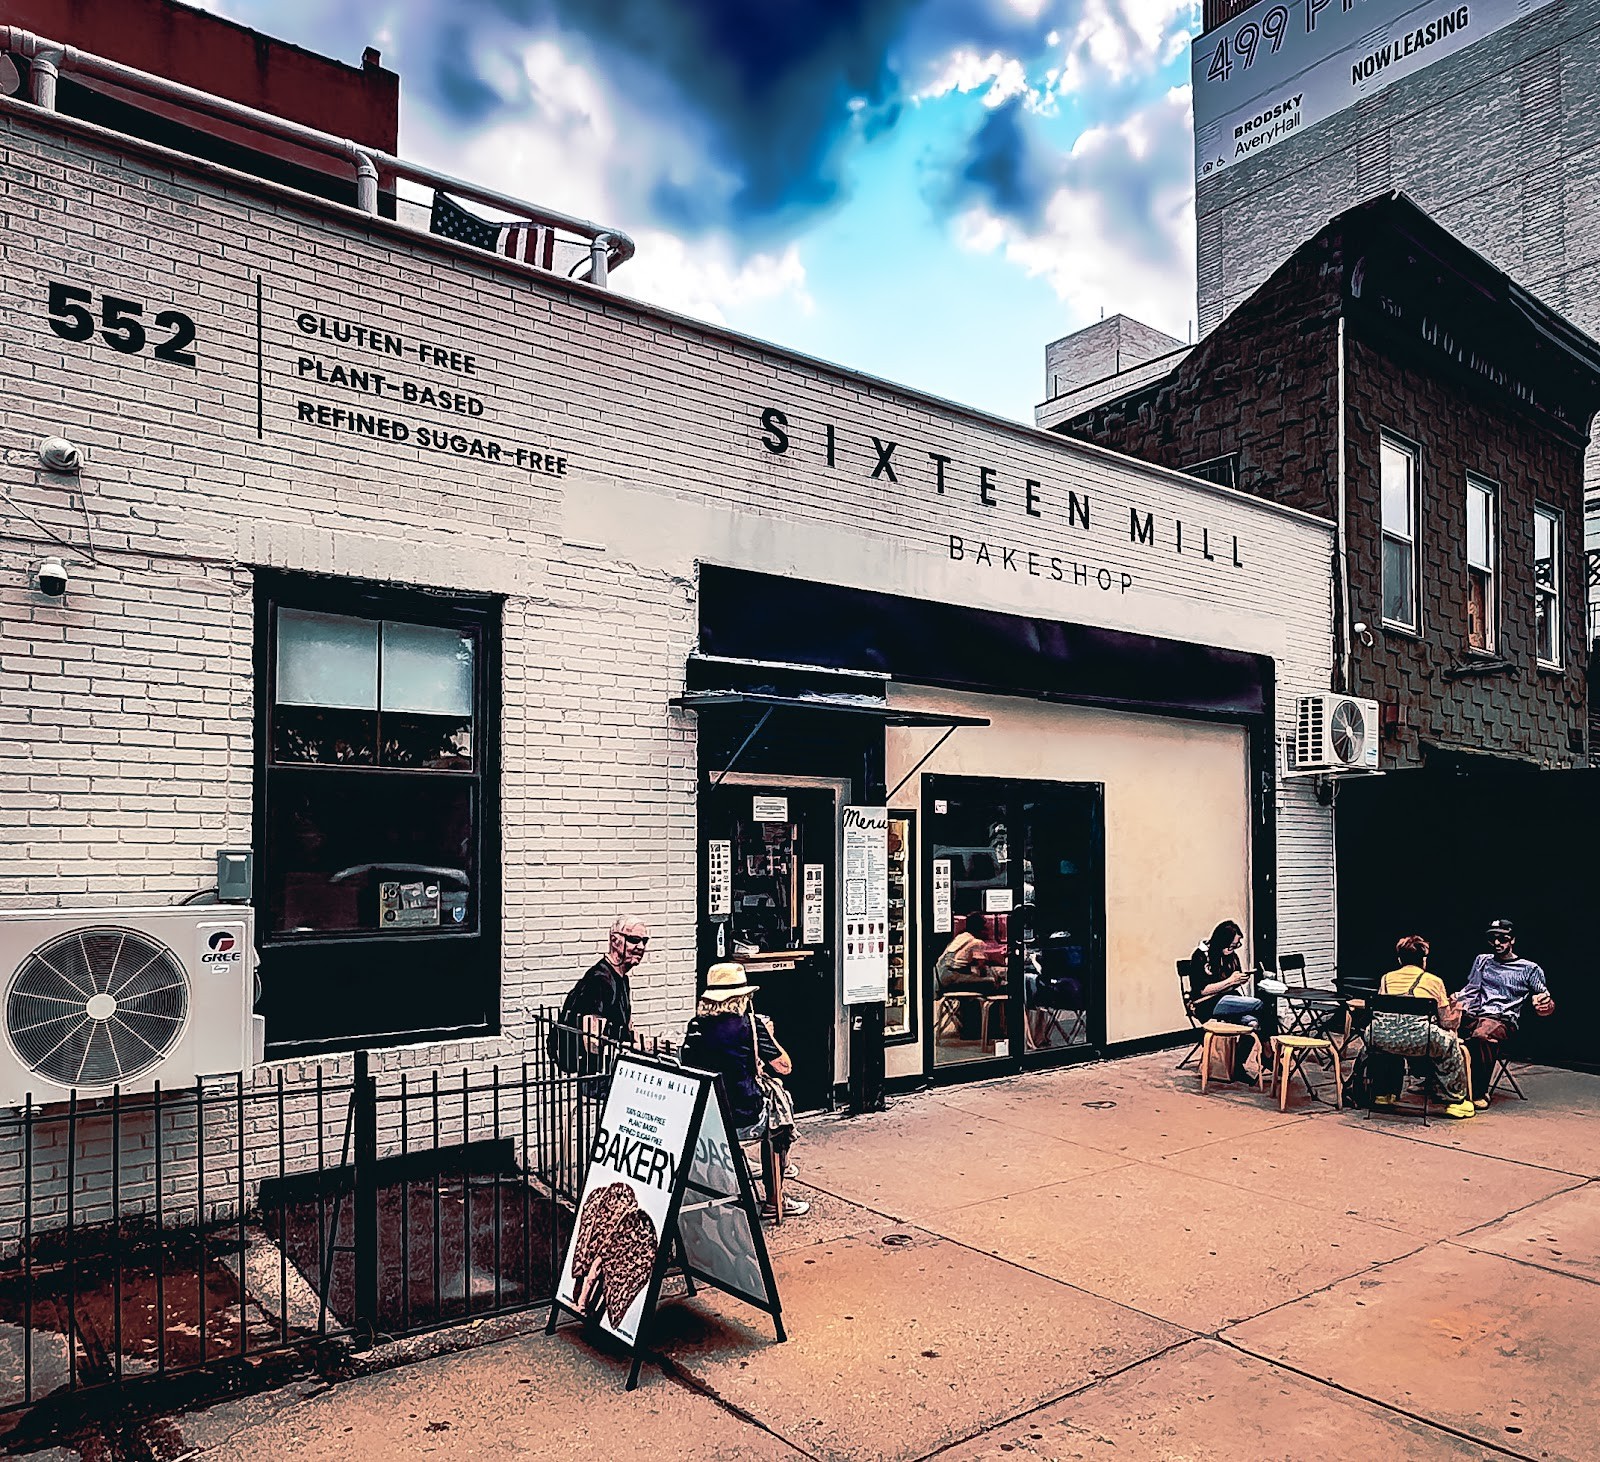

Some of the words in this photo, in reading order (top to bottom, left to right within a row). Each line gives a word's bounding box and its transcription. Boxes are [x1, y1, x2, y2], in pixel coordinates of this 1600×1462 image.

[1207, 5, 1289, 82] 499
[1352, 45, 1391, 85] NOW
[1394, 6, 1468, 61] LEASING
[1235, 93, 1302, 139] BRODSKY
[1235, 112, 1300, 158] AveryHall
[49, 281, 196, 365] 552
[297, 314, 476, 374] GLUTEN-FREE
[299, 357, 483, 417] PLANT-BASED
[299, 402, 410, 443] REFINED
[416, 427, 567, 475] SUGAR-FREE
[761, 408, 1090, 529] SIXTEEN
[1130, 508, 1243, 568] MILL
[950, 535, 1133, 594] BAKESHOP
[843, 809, 889, 830] Menu
[201, 952, 241, 963] GREE
[619, 1067, 662, 1086] SIXTEEN
[668, 1080, 694, 1096] MILL
[636, 1087, 666, 1101] BAKESHOP
[591, 1128, 680, 1193] BAKERY
